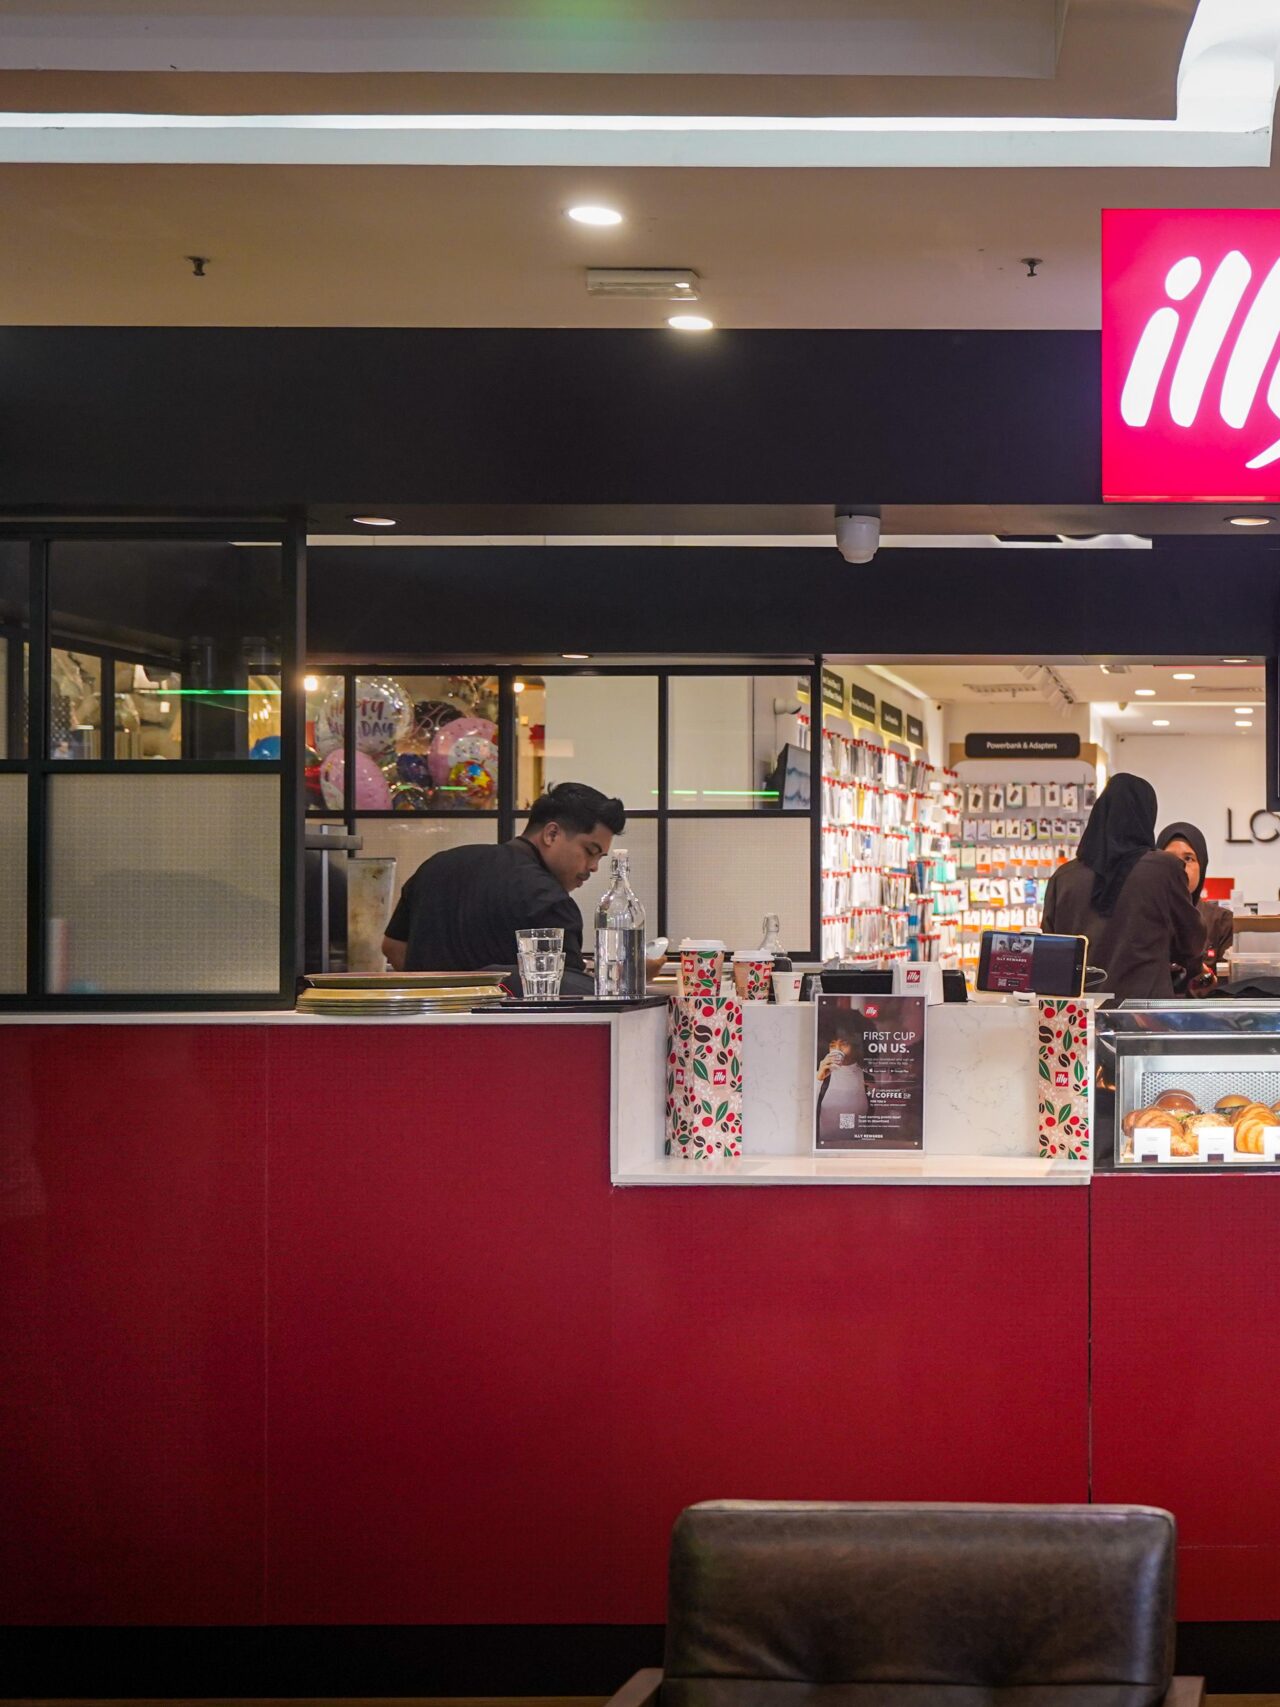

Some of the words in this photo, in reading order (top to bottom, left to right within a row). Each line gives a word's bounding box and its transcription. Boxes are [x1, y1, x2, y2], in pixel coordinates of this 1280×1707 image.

[1029, 742, 1057, 750] Adapters
[908, 972, 919, 981] illy
[866, 1007, 877, 1015] illy
[864, 1032, 891, 1040] FIRST
[893, 1032, 916, 1040] CUP
[868, 1043, 887, 1053] ON
[891, 1043, 910, 1053] US.
[714, 1072, 725, 1083] illy
[1057, 1074, 1067, 1085] illy
